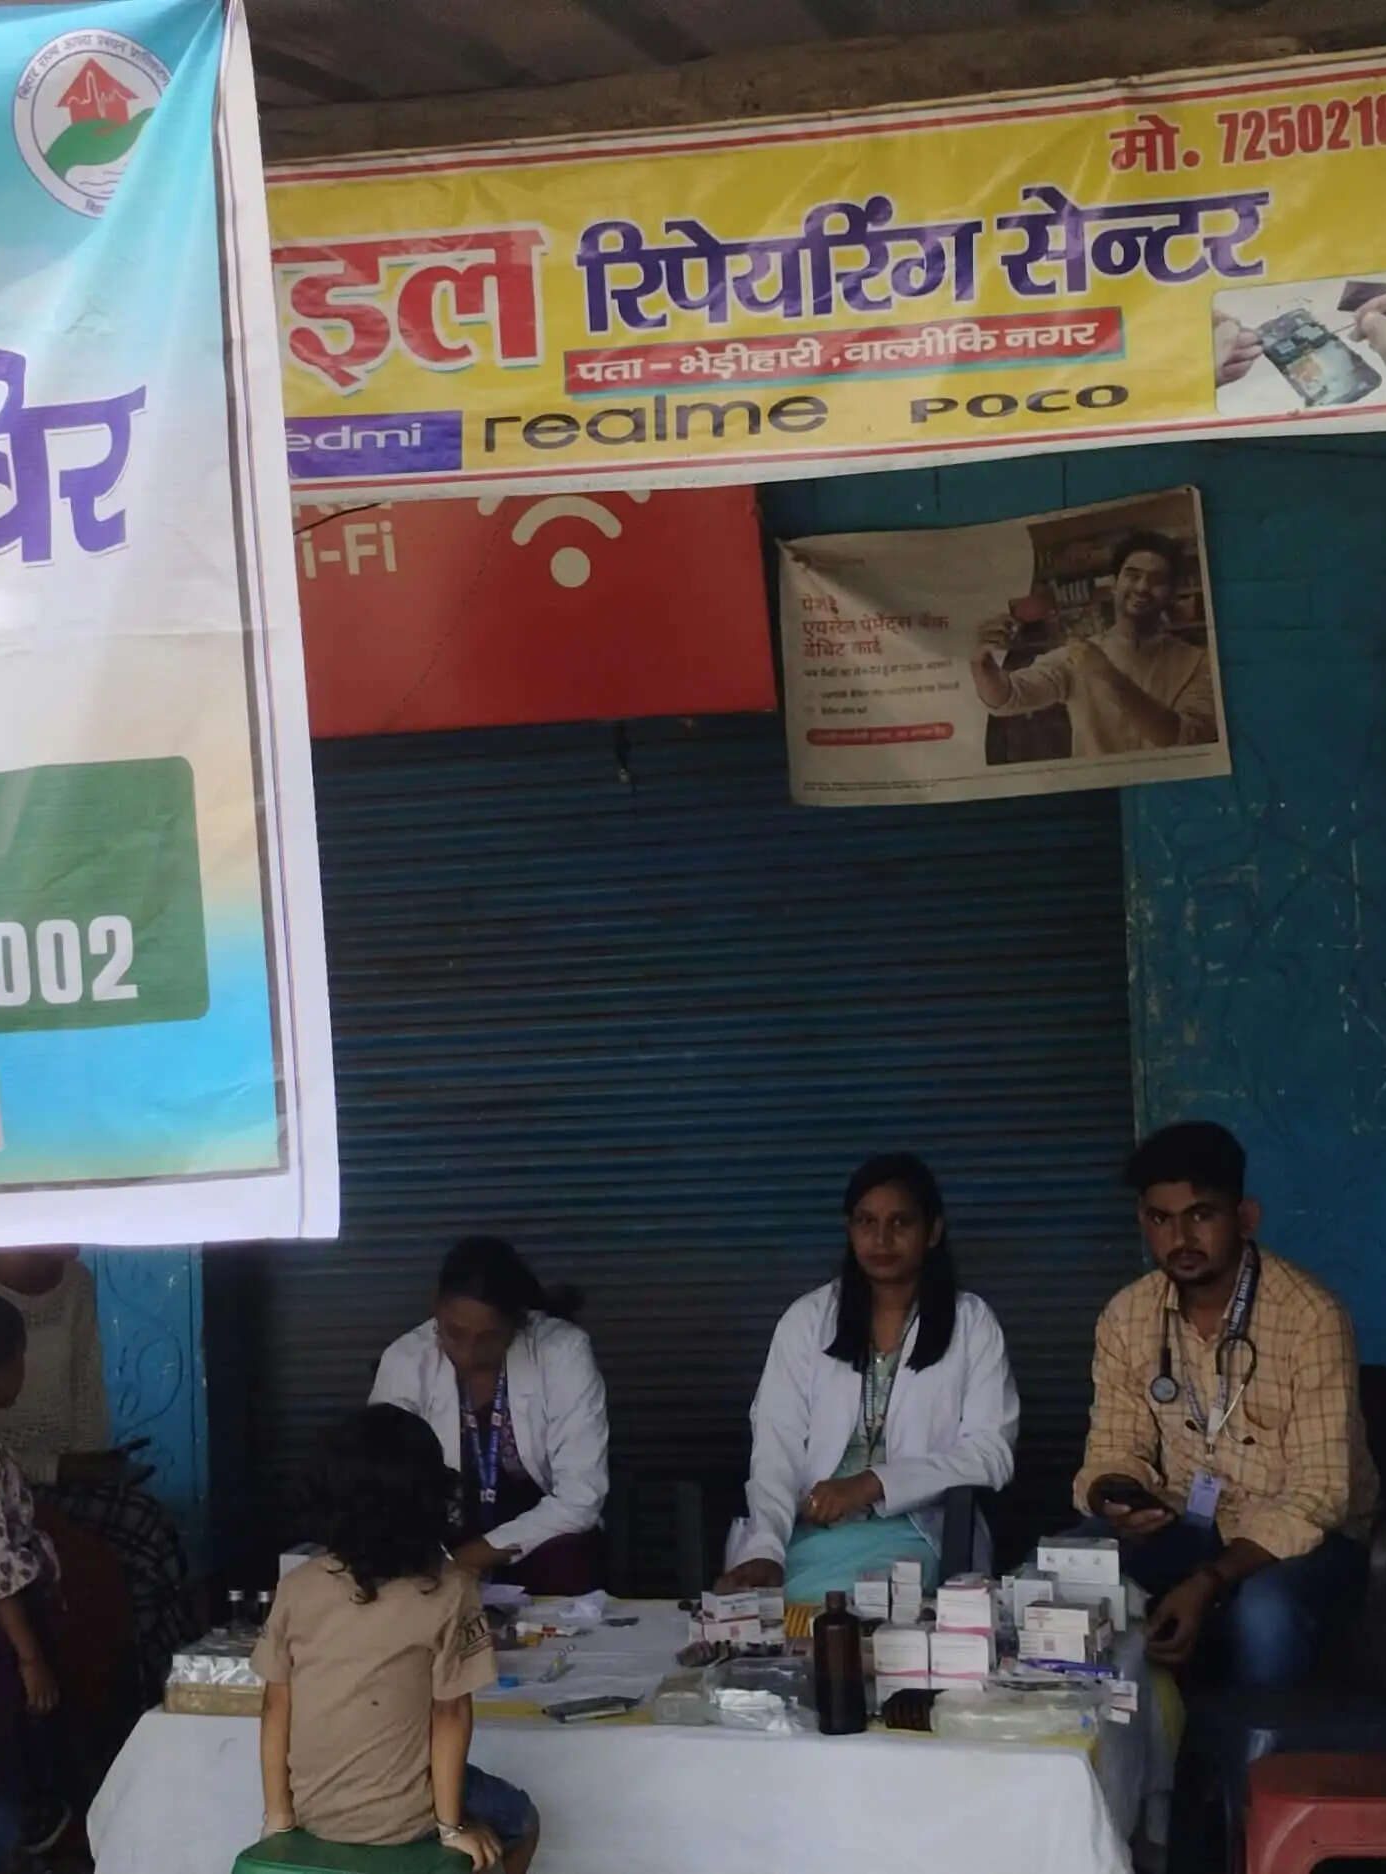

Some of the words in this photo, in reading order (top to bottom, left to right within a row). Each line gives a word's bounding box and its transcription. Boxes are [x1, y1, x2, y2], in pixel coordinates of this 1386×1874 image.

[1110, 114, 1200, 174] मो.
[577, 195, 983, 333] रिपेयरिंग
[996, 186, 1269, 298] सेन्टर
[576, 357, 644, 383] पता
[1005, 322, 1100, 350] नगर
[286, 423, 422, 452] edmi
[484, 395, 827, 454] realme
[912, 382, 1129, 424] POCO
[301, 520, 398, 580] i-Fi
